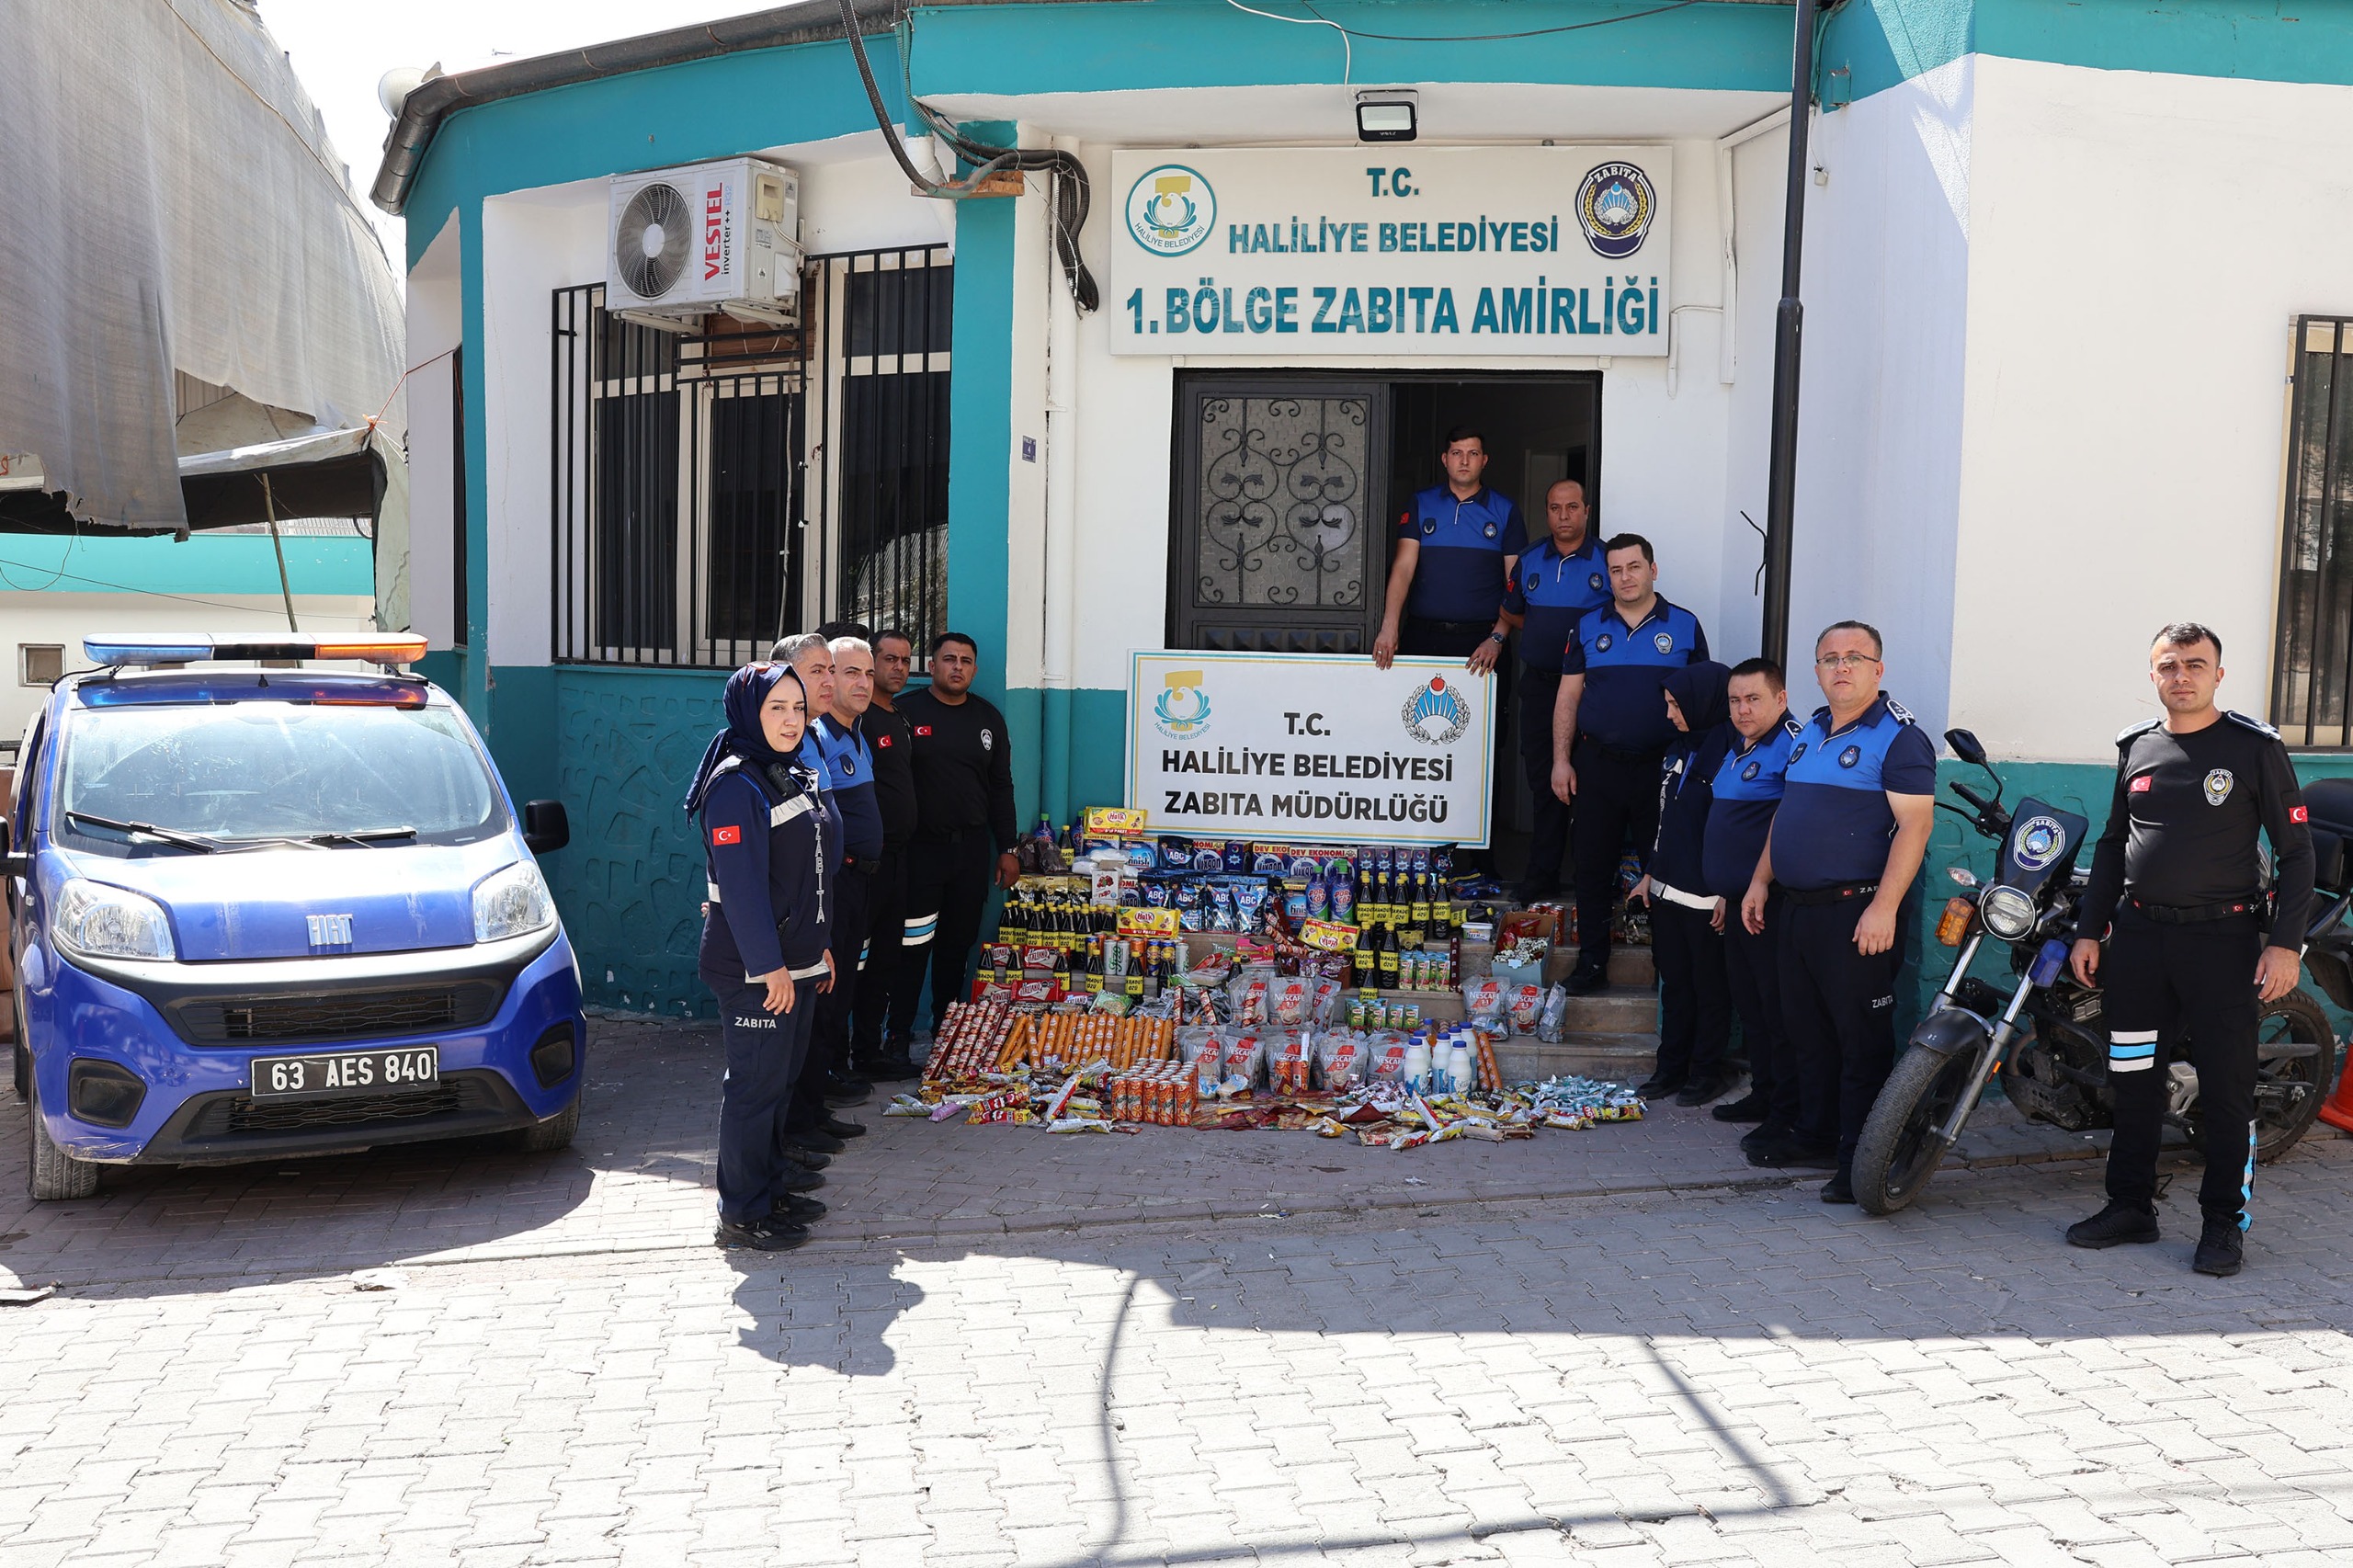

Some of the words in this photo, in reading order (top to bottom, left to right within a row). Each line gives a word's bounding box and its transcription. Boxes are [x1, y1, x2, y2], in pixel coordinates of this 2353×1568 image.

[1367, 166, 1419, 197] T.C.
[1594, 166, 1638, 183] ZABITA
[705, 182, 722, 281] VESTEL
[1134, 222, 1164, 247] HALİLİYE
[1164, 225, 1205, 248] BELEDİYESİ
[1228, 215, 1369, 254] HALİLİYE
[1379, 213, 1559, 254] BELEDİYESİ
[1311, 287, 1460, 335] ZABITA
[1472, 275, 1659, 335] AMİRLİĞİ
[1284, 711, 1331, 736] T.C.
[1162, 746, 1285, 777] HALİLİYE
[1293, 751, 1452, 782] BELEDİYESİ
[1164, 790, 1264, 817] ZABITA
[1272, 790, 1449, 824] MÜDÜRLÜĞÜ
[1168, 851, 1185, 861] ABC
[814, 824, 825, 924] ZABITA
[1148, 889, 1164, 900] ABC
[1176, 892, 1194, 903] ABC
[1240, 895, 1256, 904] ABC
[306, 914, 353, 947] FIAT
[734, 1017, 778, 1028] ZABITA
[271, 1062, 304, 1091] 63
[325, 1057, 373, 1087] AES
[384, 1052, 431, 1083] 840
